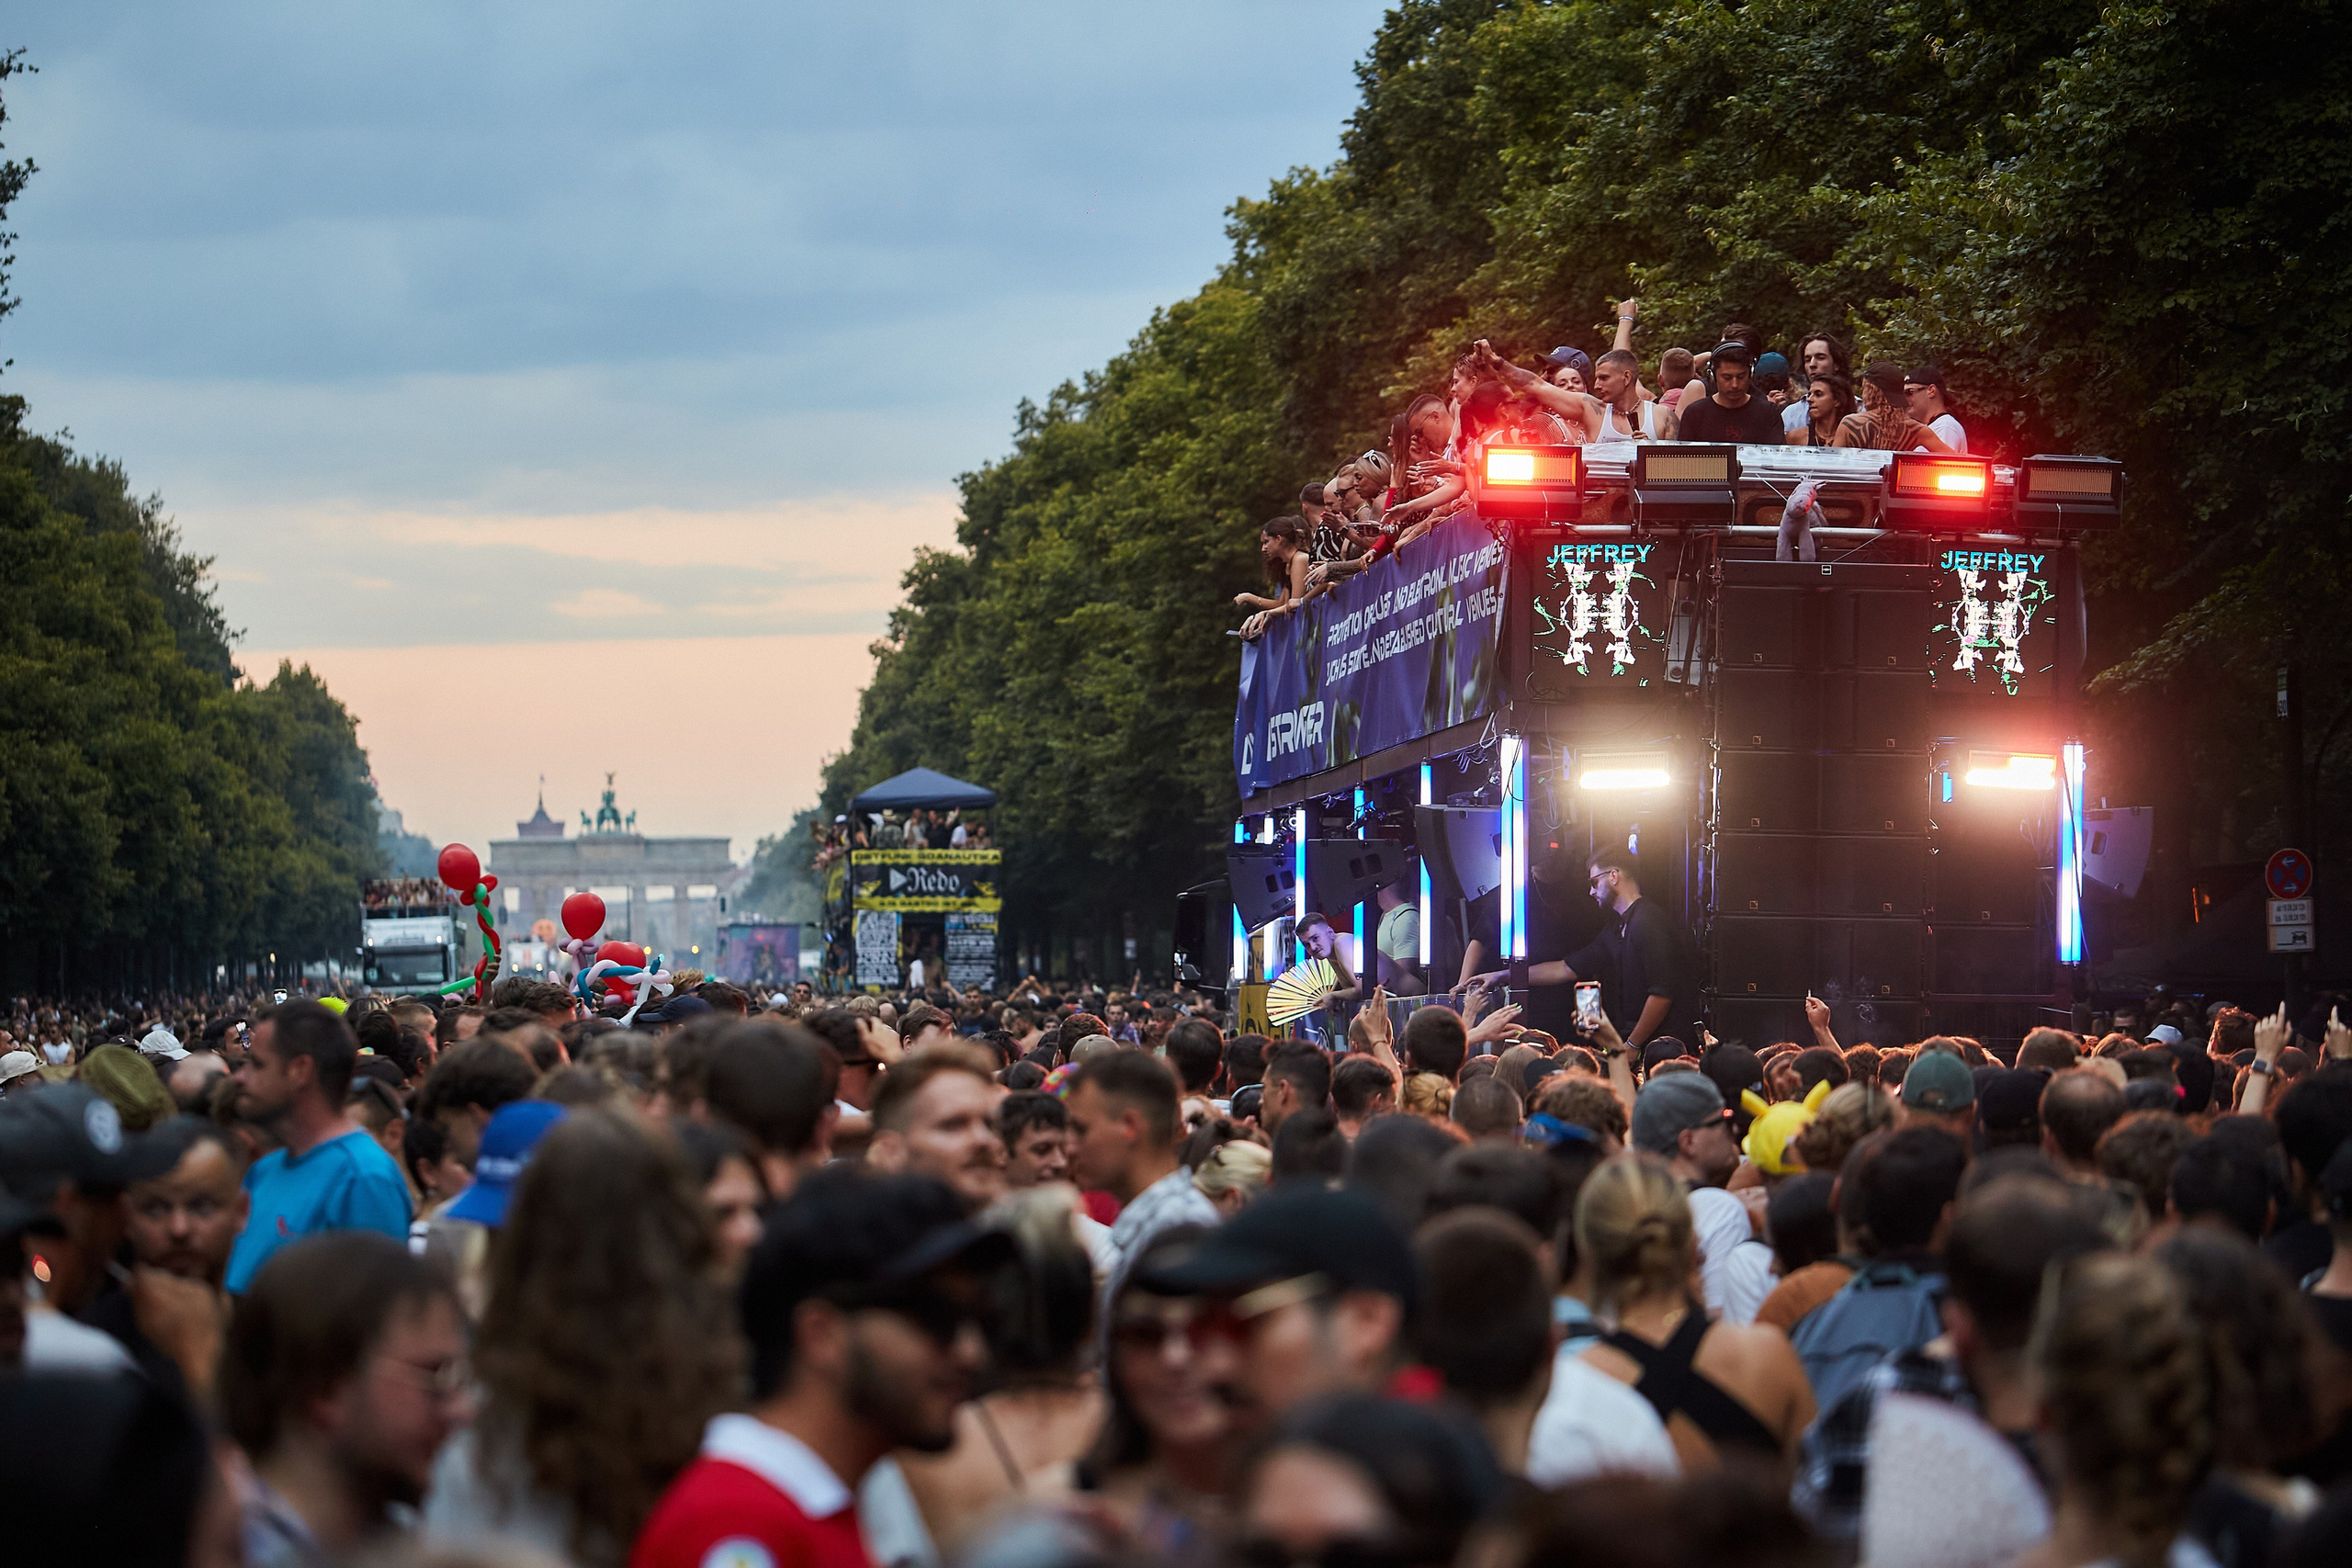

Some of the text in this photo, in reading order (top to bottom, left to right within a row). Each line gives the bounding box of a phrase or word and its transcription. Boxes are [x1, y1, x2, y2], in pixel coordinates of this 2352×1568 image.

[1547, 544, 1652, 563] JEFFREY
[1940, 549, 2045, 573] JEFFREY
[1465, 585, 1498, 624] VENUES
[906, 867, 961, 893] Redo
